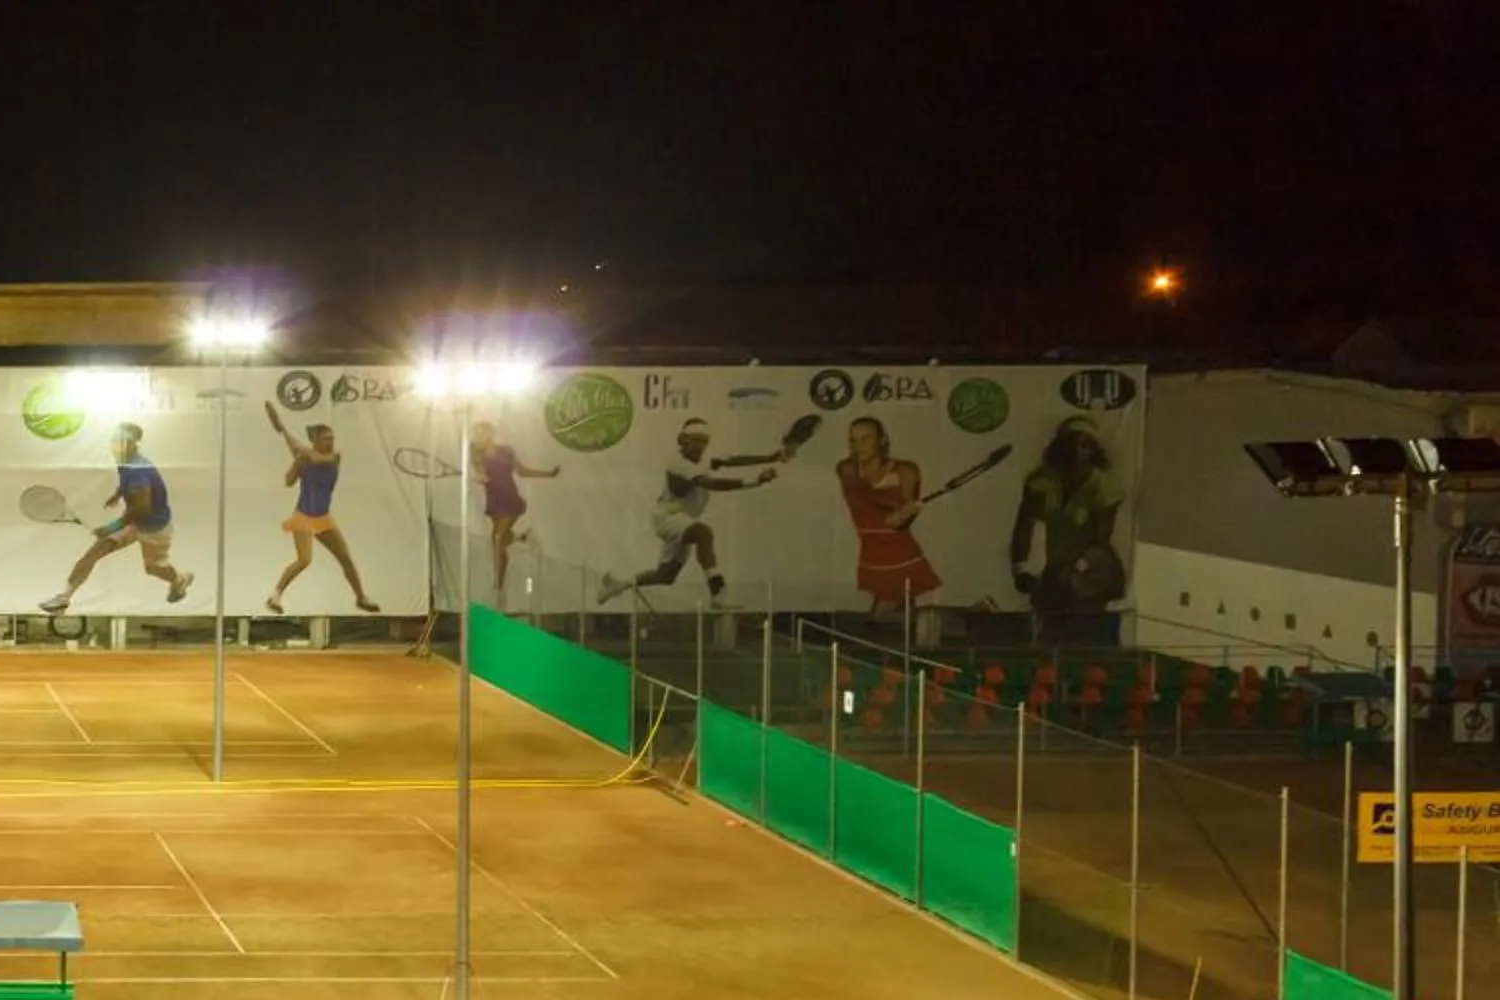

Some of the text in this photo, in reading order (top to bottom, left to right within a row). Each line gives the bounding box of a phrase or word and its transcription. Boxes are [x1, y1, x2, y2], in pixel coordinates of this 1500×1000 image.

[345, 375, 398, 402] SPA
[879, 374, 934, 401] SPA
[1422, 803, 1481, 821] Safety
